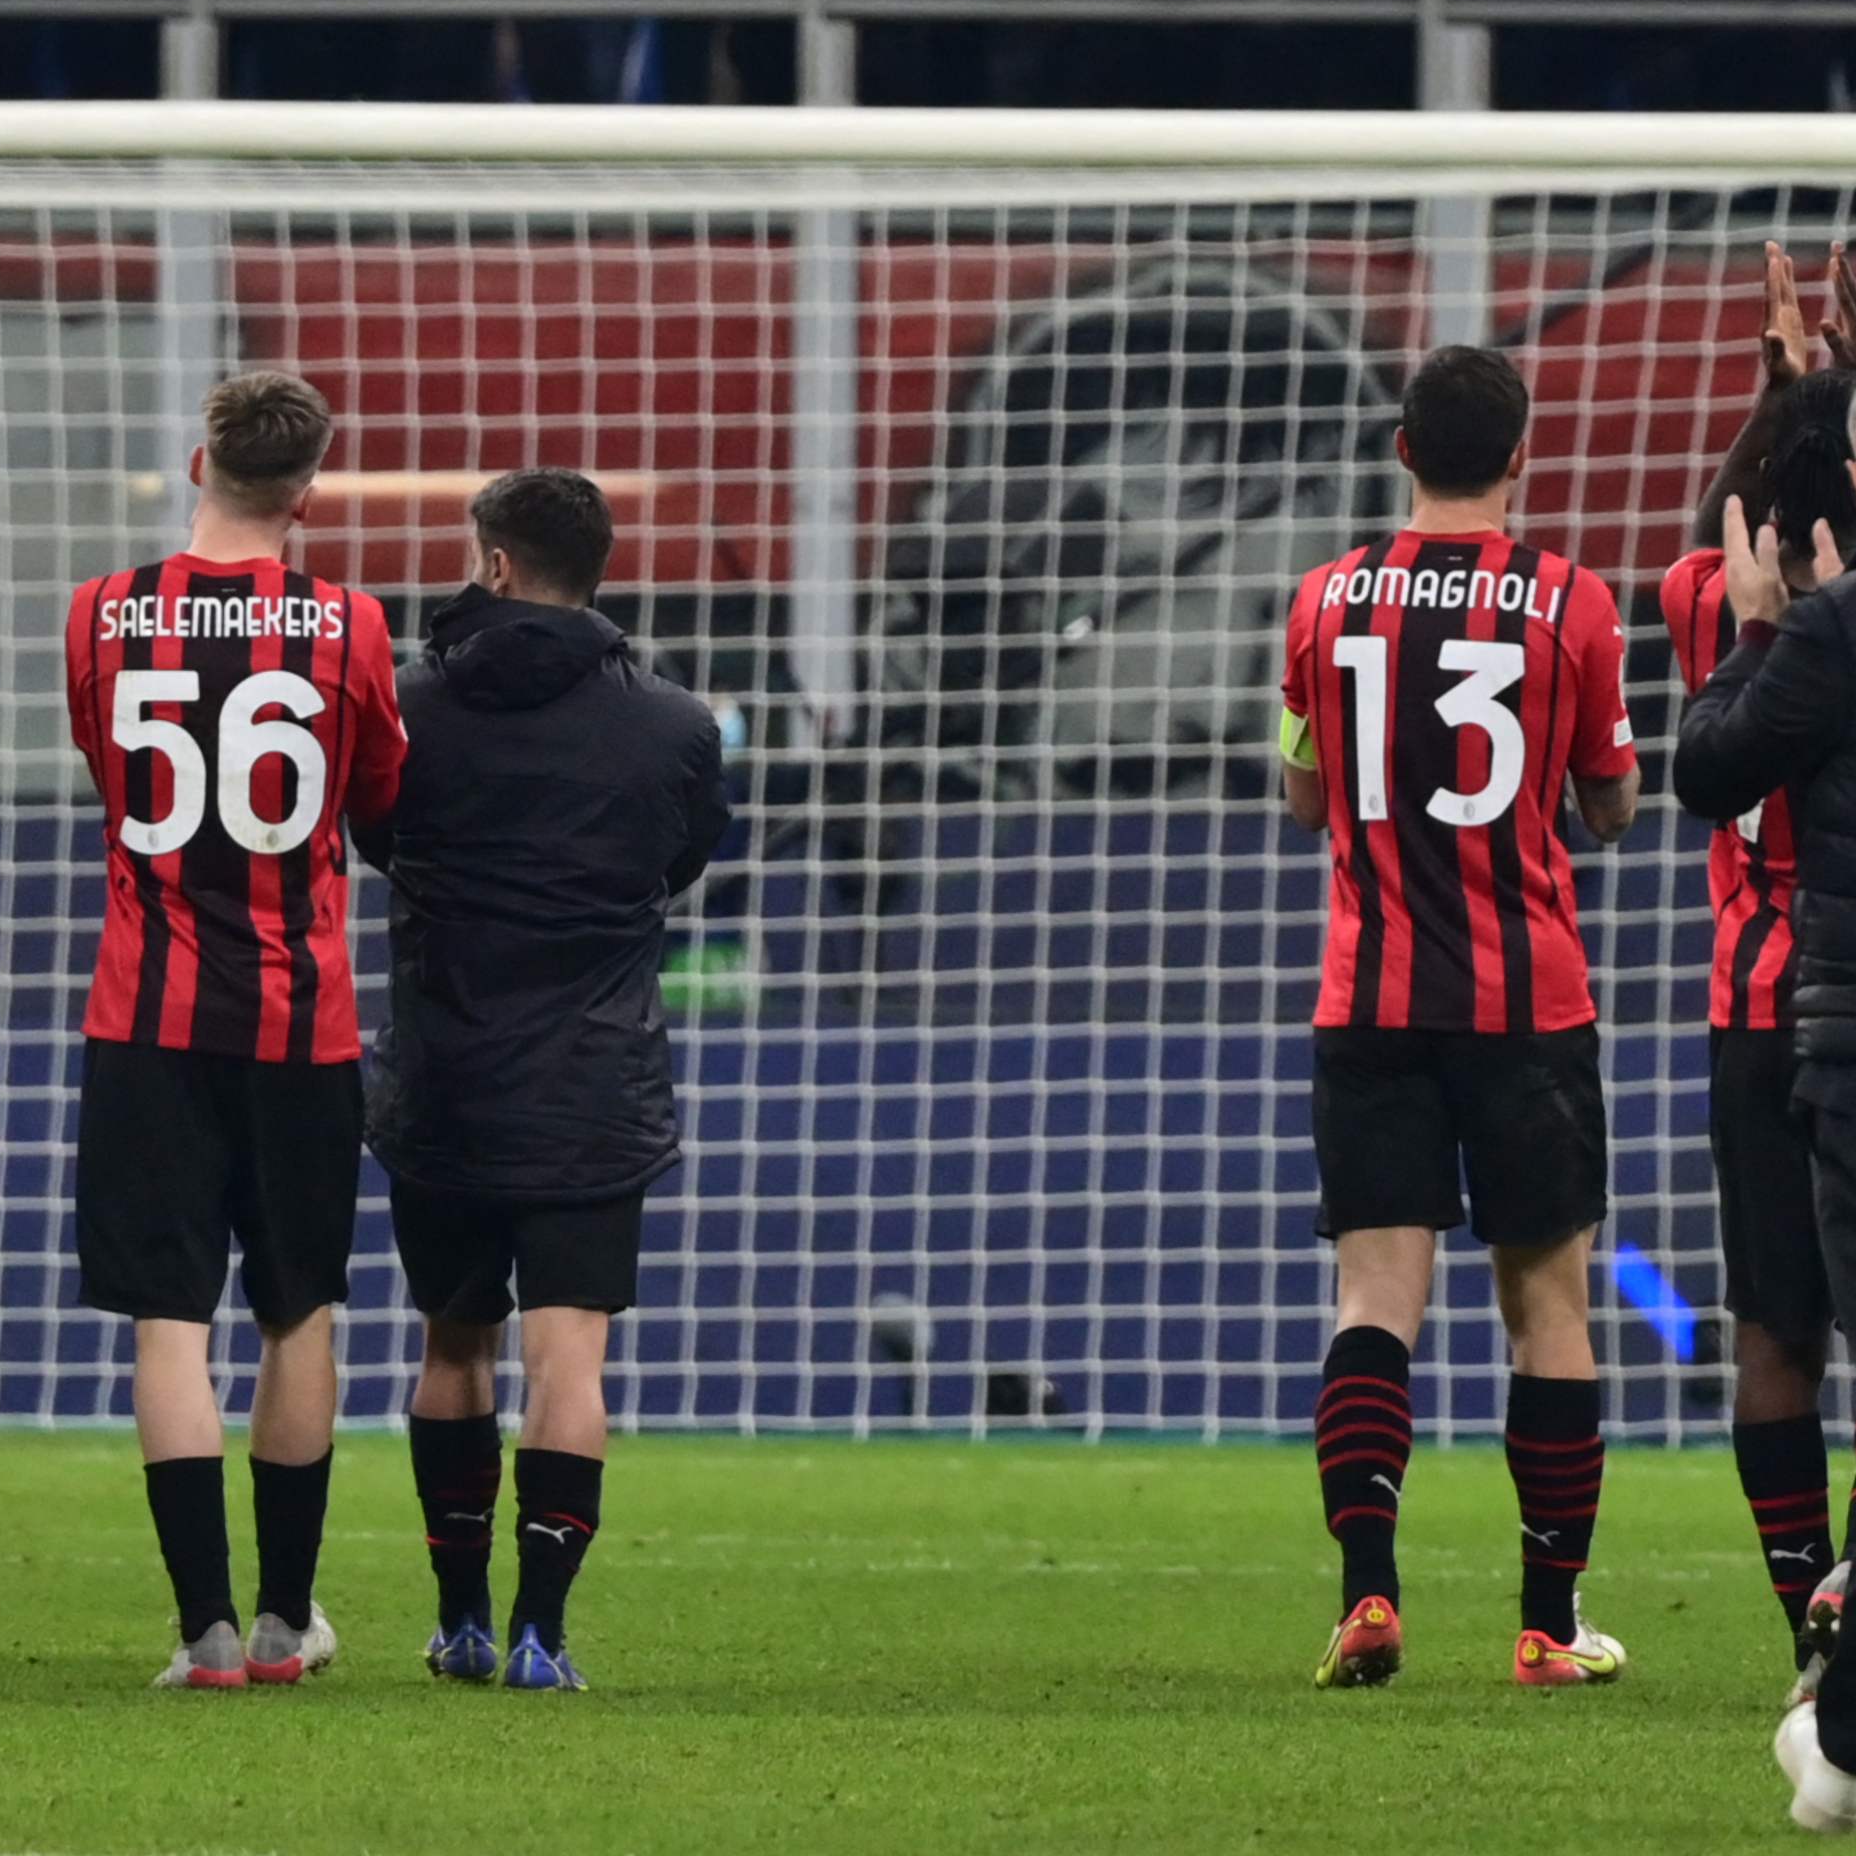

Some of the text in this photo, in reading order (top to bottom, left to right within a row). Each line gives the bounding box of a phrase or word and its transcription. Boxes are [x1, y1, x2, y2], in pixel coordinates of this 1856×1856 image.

[100, 595, 343, 640] SAELEMAEKERS
[1321, 566, 1561, 623] ROMAGNOLI
[112, 670, 326, 855] 56
[1333, 635, 1525, 827] 13
